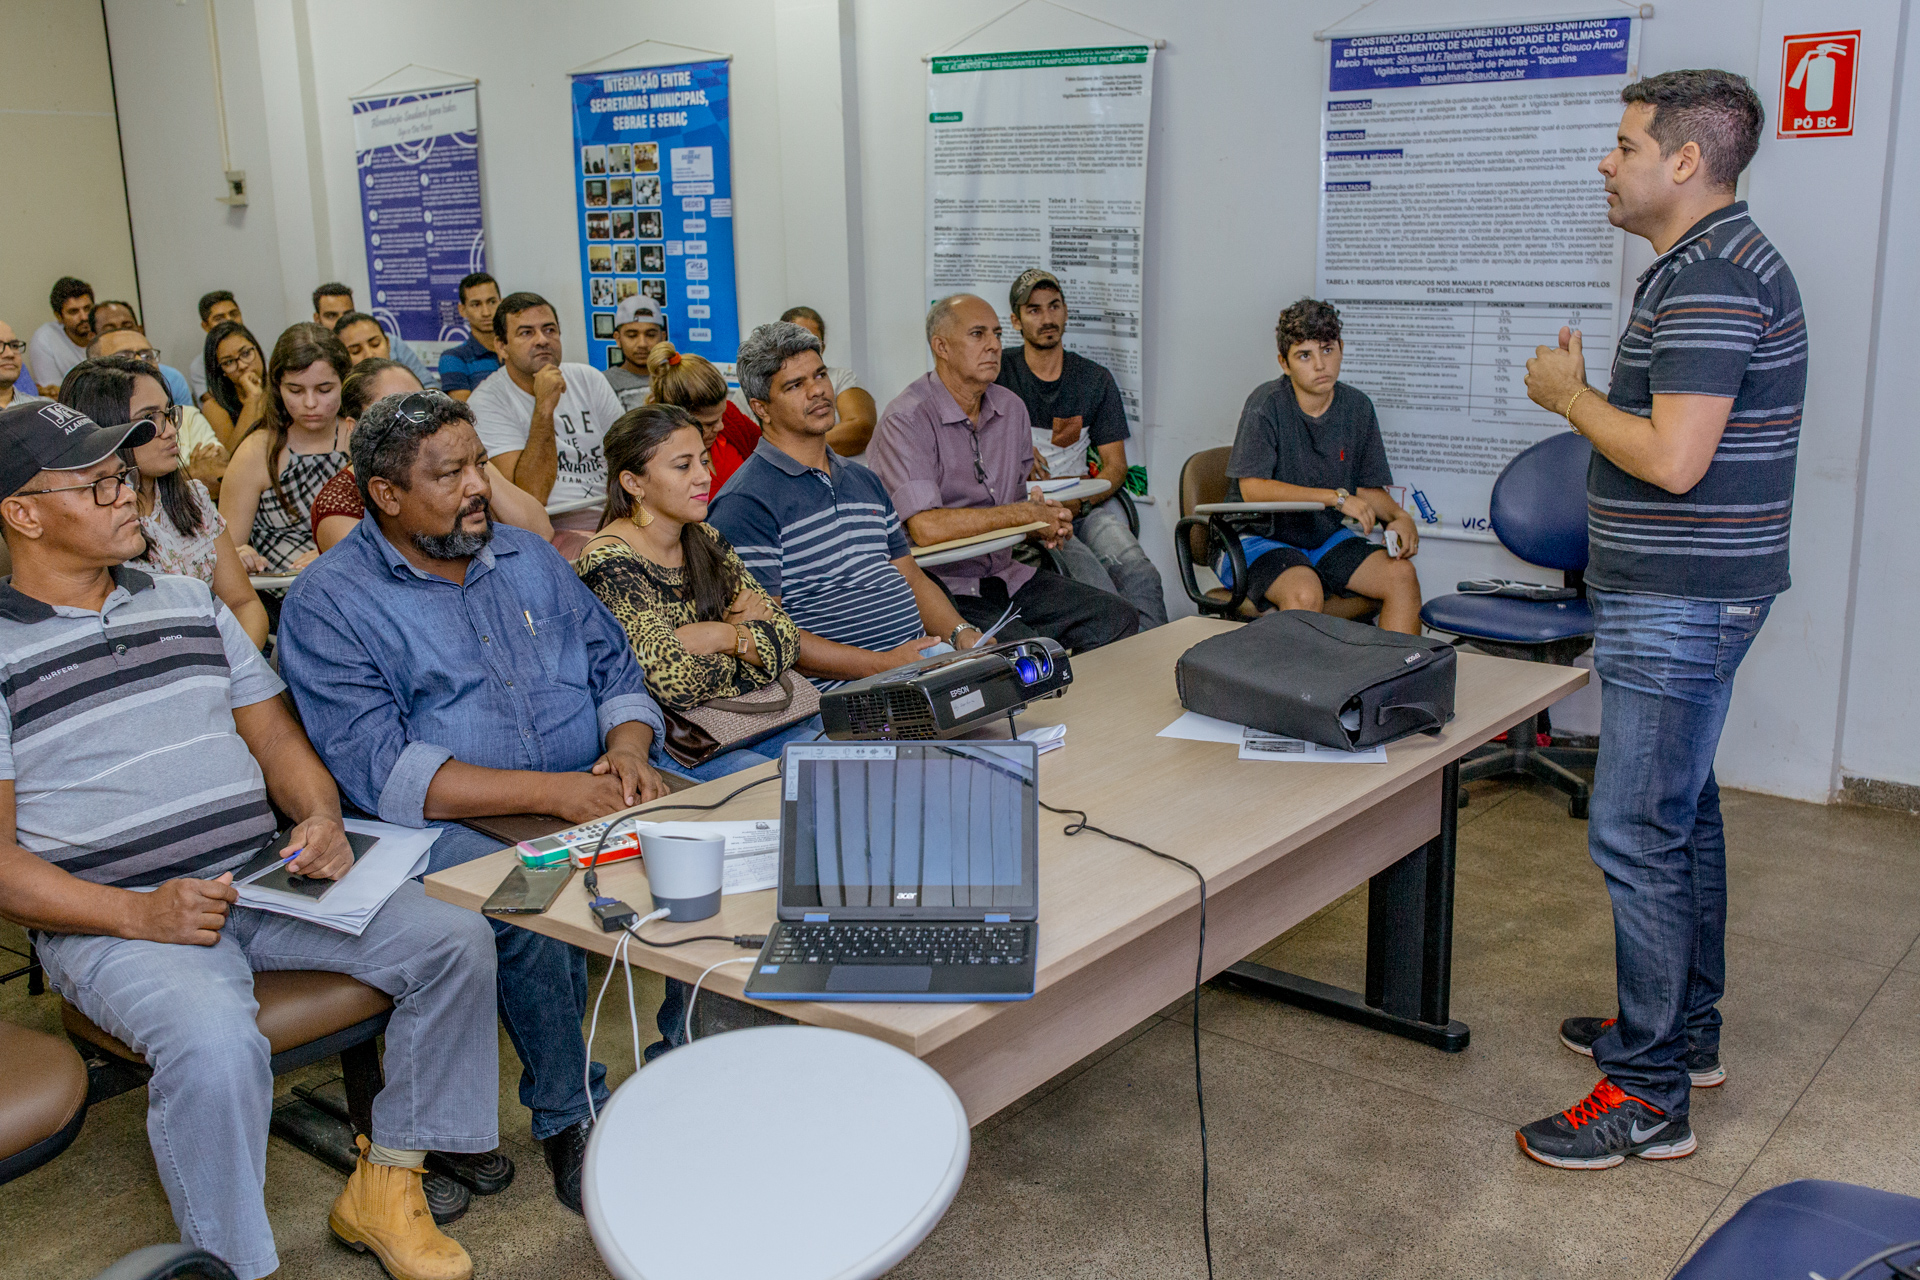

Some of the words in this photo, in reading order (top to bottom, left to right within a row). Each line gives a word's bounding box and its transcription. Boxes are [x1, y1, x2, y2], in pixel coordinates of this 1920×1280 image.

[1412, 33, 1425, 41] DO
[1427, 27, 1505, 40] MONITORAMENTO
[1508, 26, 1522, 34] DO
[1525, 23, 1553, 32] RISCO
[1344, 48, 1356, 57] EM
[1357, 41, 1445, 56] ESTABELECIMENTOS
[1447, 40, 1459, 49] DE
[1461, 36, 1492, 48] SAÚDE
[1494, 36, 1508, 46] NA
[1509, 33, 1544, 45] CIDADE
[1546, 32, 1560, 42] DE
[1562, 28, 1618, 41] PALMAS-TO
[1335, 58, 1360, 68] Márcio
[1396, 53, 1424, 65] Silvana
[1517, 46, 1527, 55] R.
[1561, 41, 1591, 52] Glauco
[1373, 65, 1409, 77] Vigilância
[1411, 62, 1444, 73] Sanitária
[1446, 60, 1483, 72] Municipal
[1485, 59, 1496, 68] de
[1498, 56, 1528, 67] Palmas
[1537, 53, 1577, 64] Tocantins
[603, 73, 659, 93] INTEGRAÇÃO
[661, 71, 691, 87] ENTRE
[590, 94, 648, 113] SECRETARIAS
[651, 90, 709, 109] MUNICIPAIS,
[613, 115, 648, 131] SEBRAE
[649, 114, 655, 128] E
[657, 112, 688, 128] SENAC
[1794, 115, 1813, 129] PÓ
[1817, 116, 1836, 128] BC
[1411, 432, 1448, 440] ferramentas
[1472, 436, 1498, 444] inserção
[1415, 456, 1444, 464] eficientes
[1469, 460, 1490, 468] código
[1437, 465, 1468, 474] promoção
[557, 475, 582, 483] REAM
[38, 663, 79, 682] SURFERS
[950, 685, 969, 698] EPSON
[896, 892, 917, 900] acer
